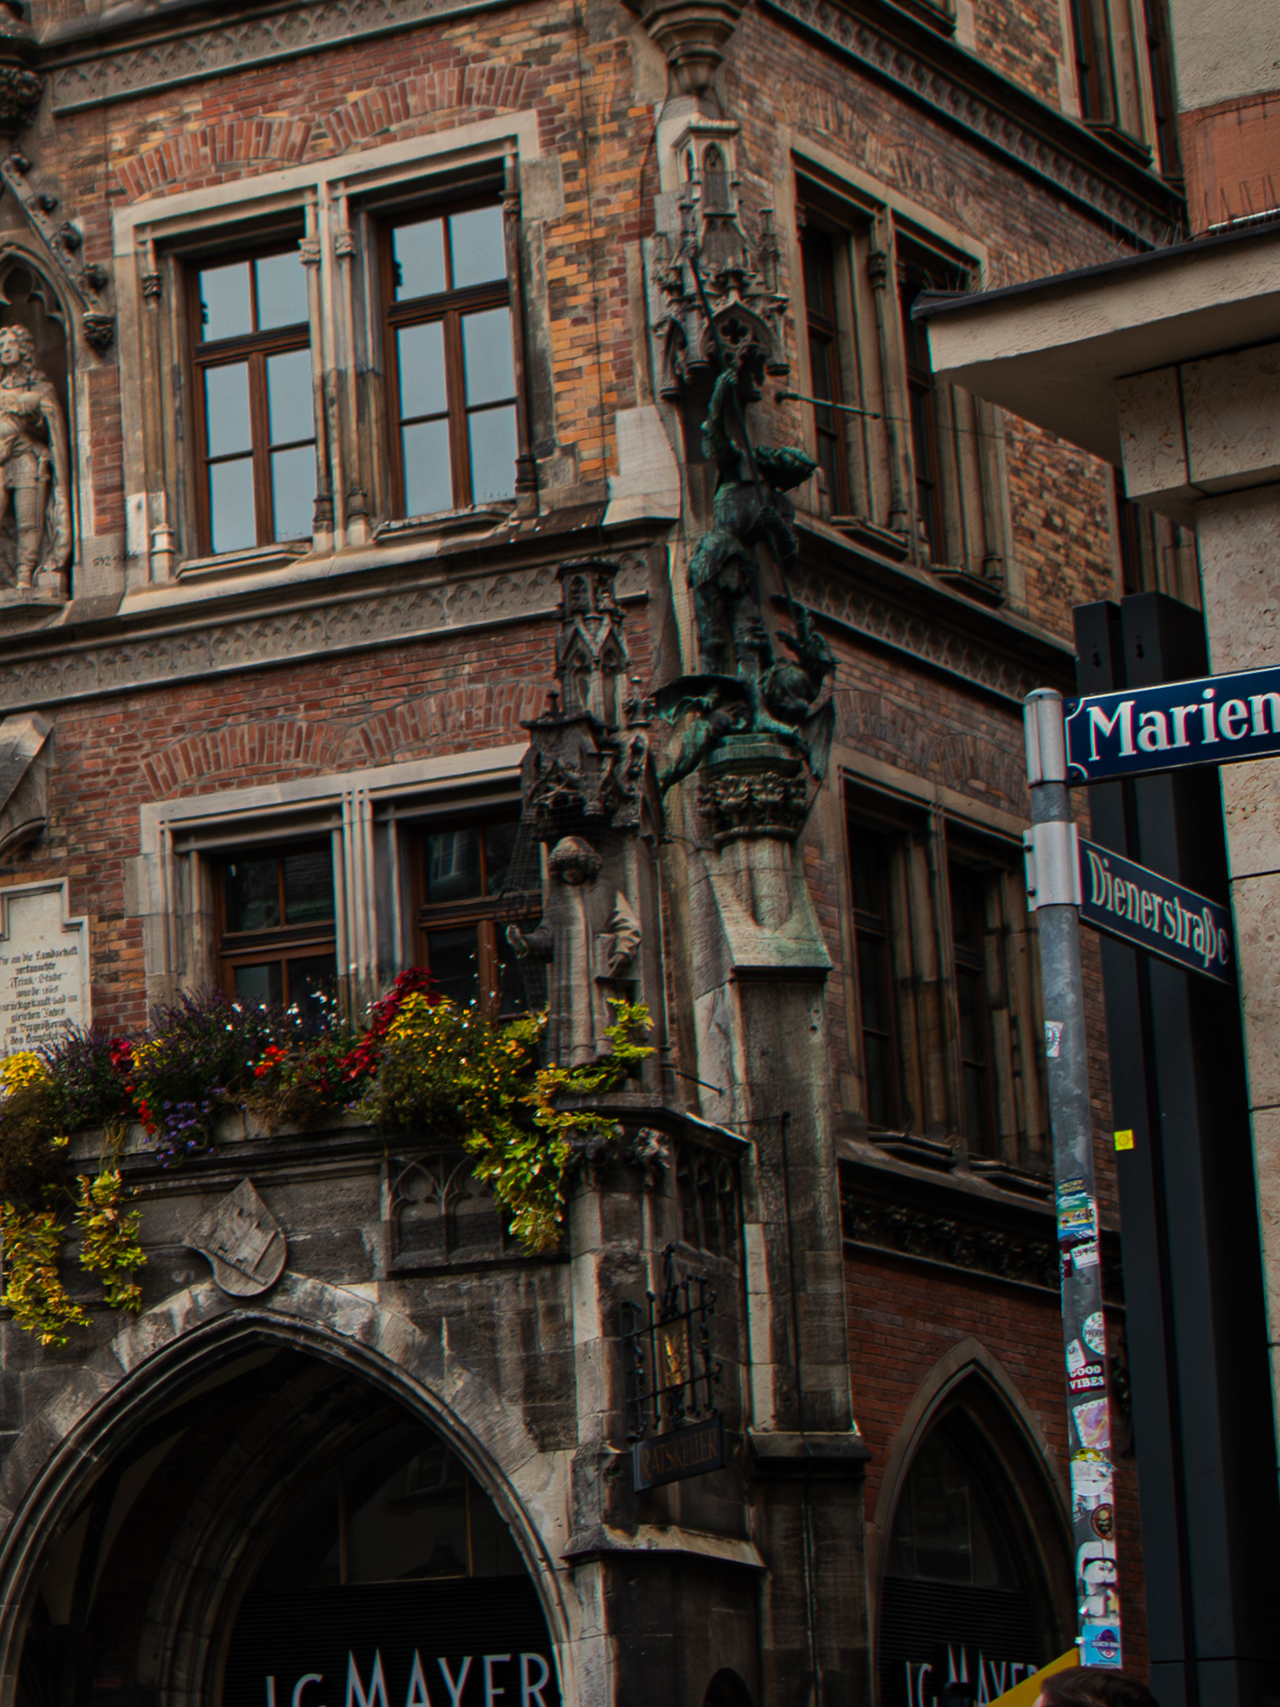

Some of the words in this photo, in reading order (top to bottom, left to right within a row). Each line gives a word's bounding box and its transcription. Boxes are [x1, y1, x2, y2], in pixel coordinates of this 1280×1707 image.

[1086, 688, 1280, 762] Marien
[1086, 850, 1229, 968] Dienerstraße
[1069, 1376, 1105, 1390] VIBES
